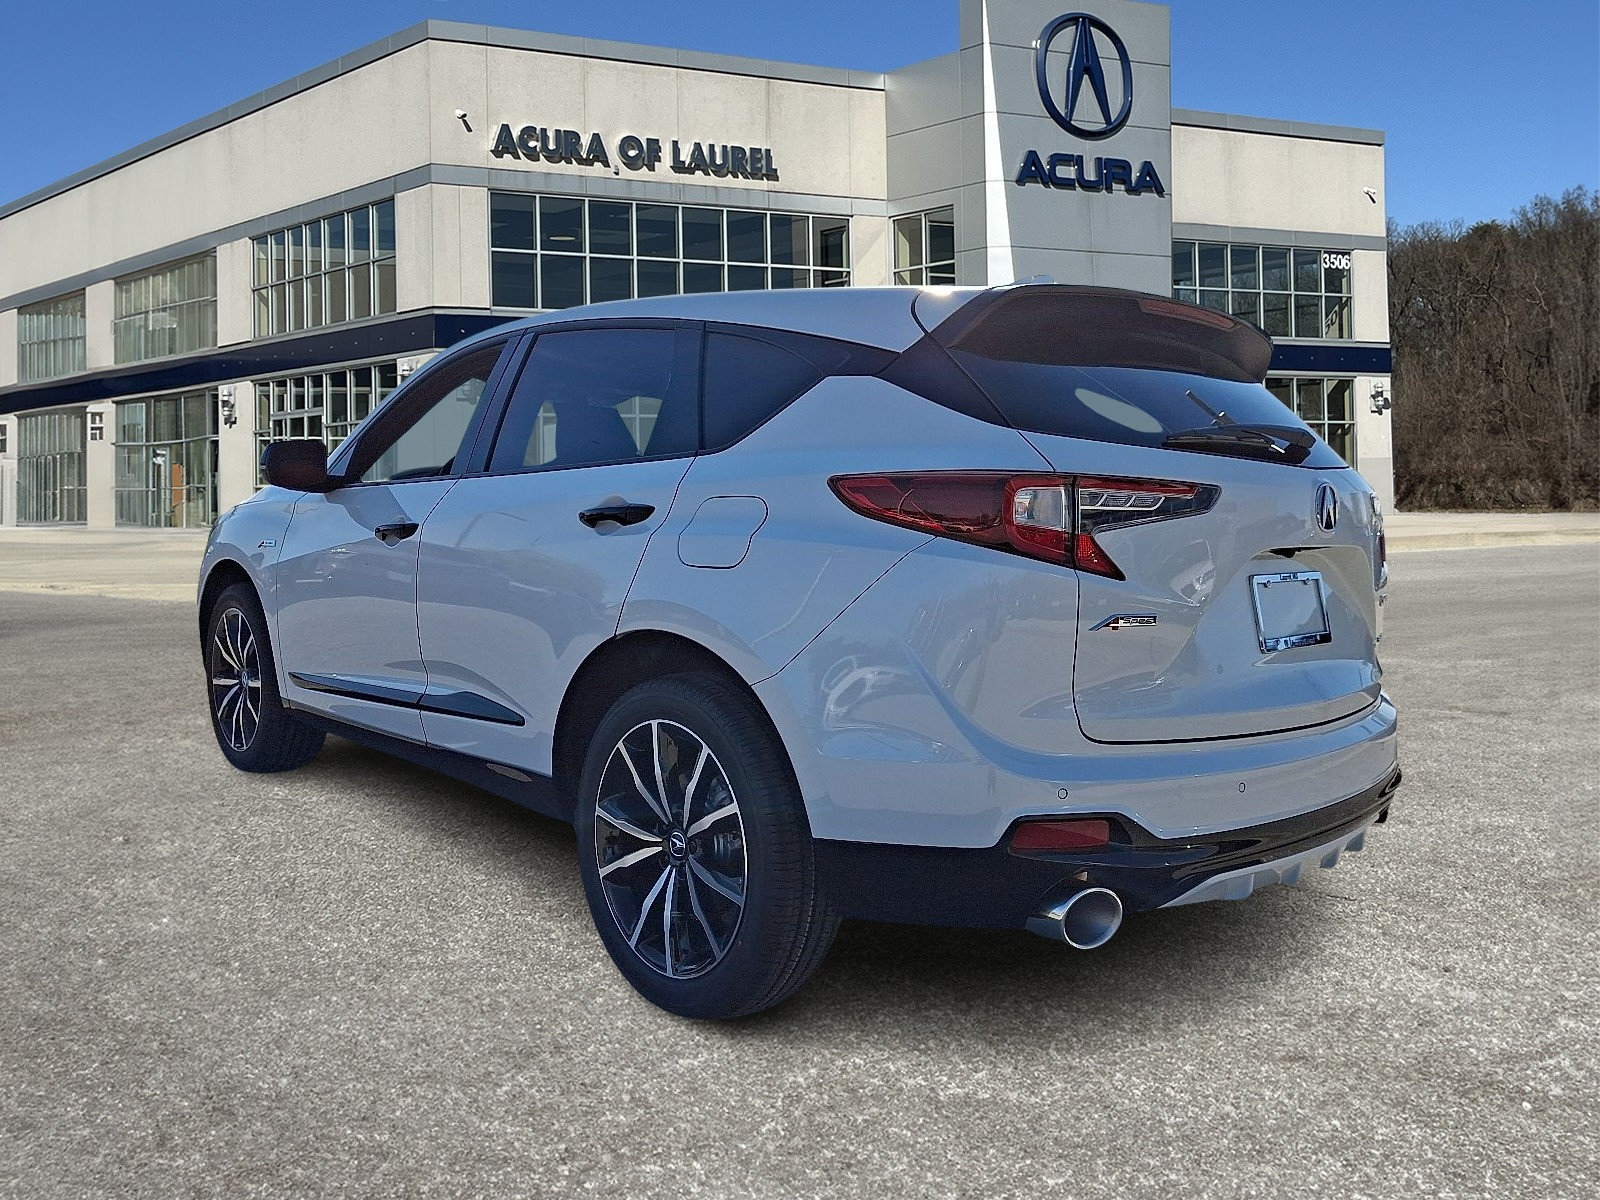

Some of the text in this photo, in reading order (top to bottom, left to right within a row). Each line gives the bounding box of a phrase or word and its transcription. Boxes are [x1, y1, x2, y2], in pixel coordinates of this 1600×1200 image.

[491, 123, 778, 180] ACURA OF LAUREL
[1016, 150, 1165, 197] ACURA
[1322, 253, 1351, 270] 3506
